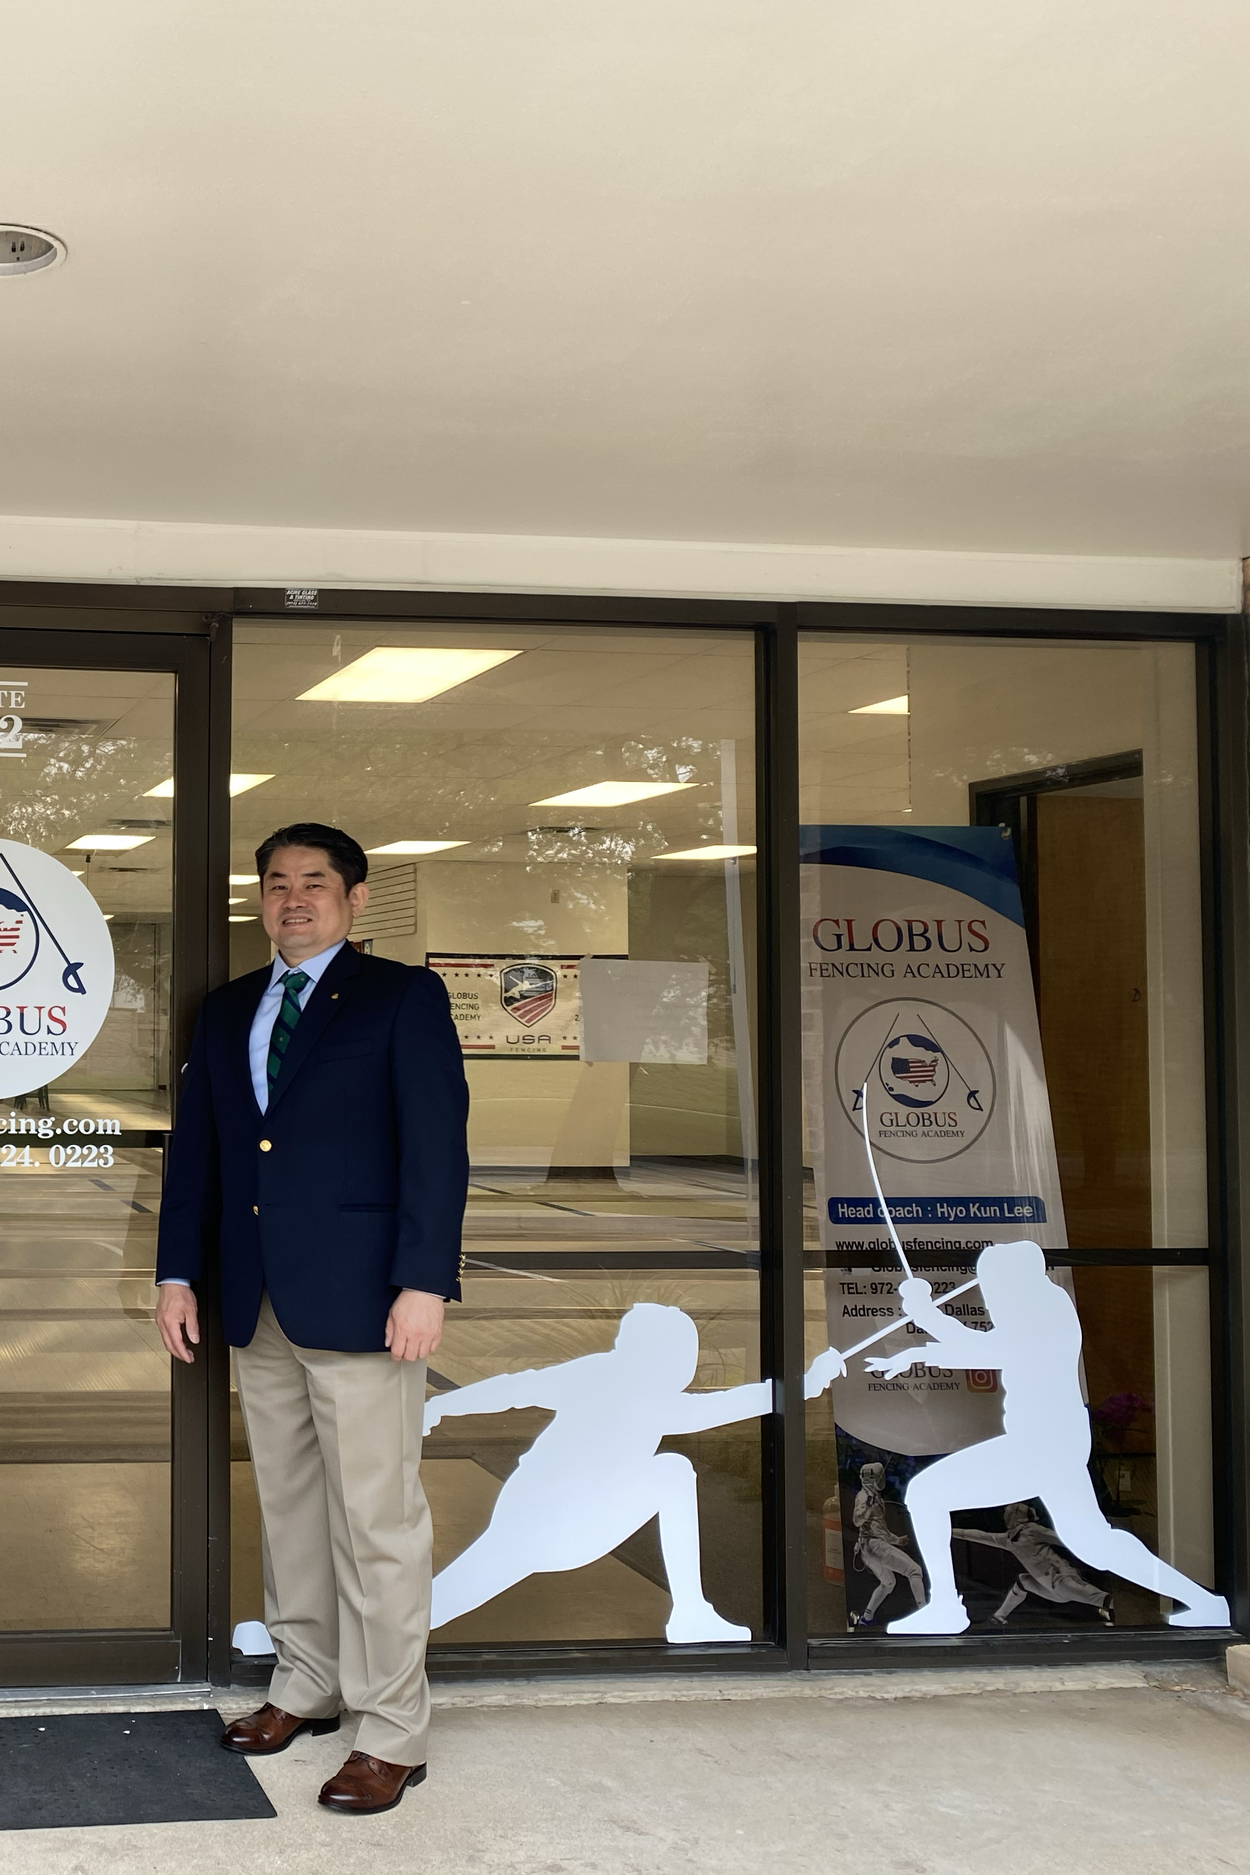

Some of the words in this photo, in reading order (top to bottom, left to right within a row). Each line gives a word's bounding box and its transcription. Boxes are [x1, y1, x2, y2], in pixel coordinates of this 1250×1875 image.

[812, 917, 991, 954] GLOBUS
[808, 962, 896, 979] FENCING
[903, 962, 1006, 979] ACADEMY
[506, 1034, 552, 1045] USA
[880, 1111, 958, 1128] GLOBUS
[878, 1130, 918, 1138] FENCING
[921, 1130, 965, 1138] ACADEMY
[48, 1144, 115, 1168] 0223
[838, 1203, 873, 1218] Head
[877, 1203, 922, 1218] coach
[937, 1203, 966, 1221] Hyo
[970, 1203, 1000, 1218] Kun
[1004, 1202, 1034, 1218] Lee
[839, 1282, 867, 1295] TEL:
[842, 1303, 895, 1317] Address
[944, 1303, 986, 1317] Dallas
[870, 1361, 954, 1379] OBUS
[868, 1382, 910, 1392] FENCING
[913, 1382, 961, 1392] ACADEMY
